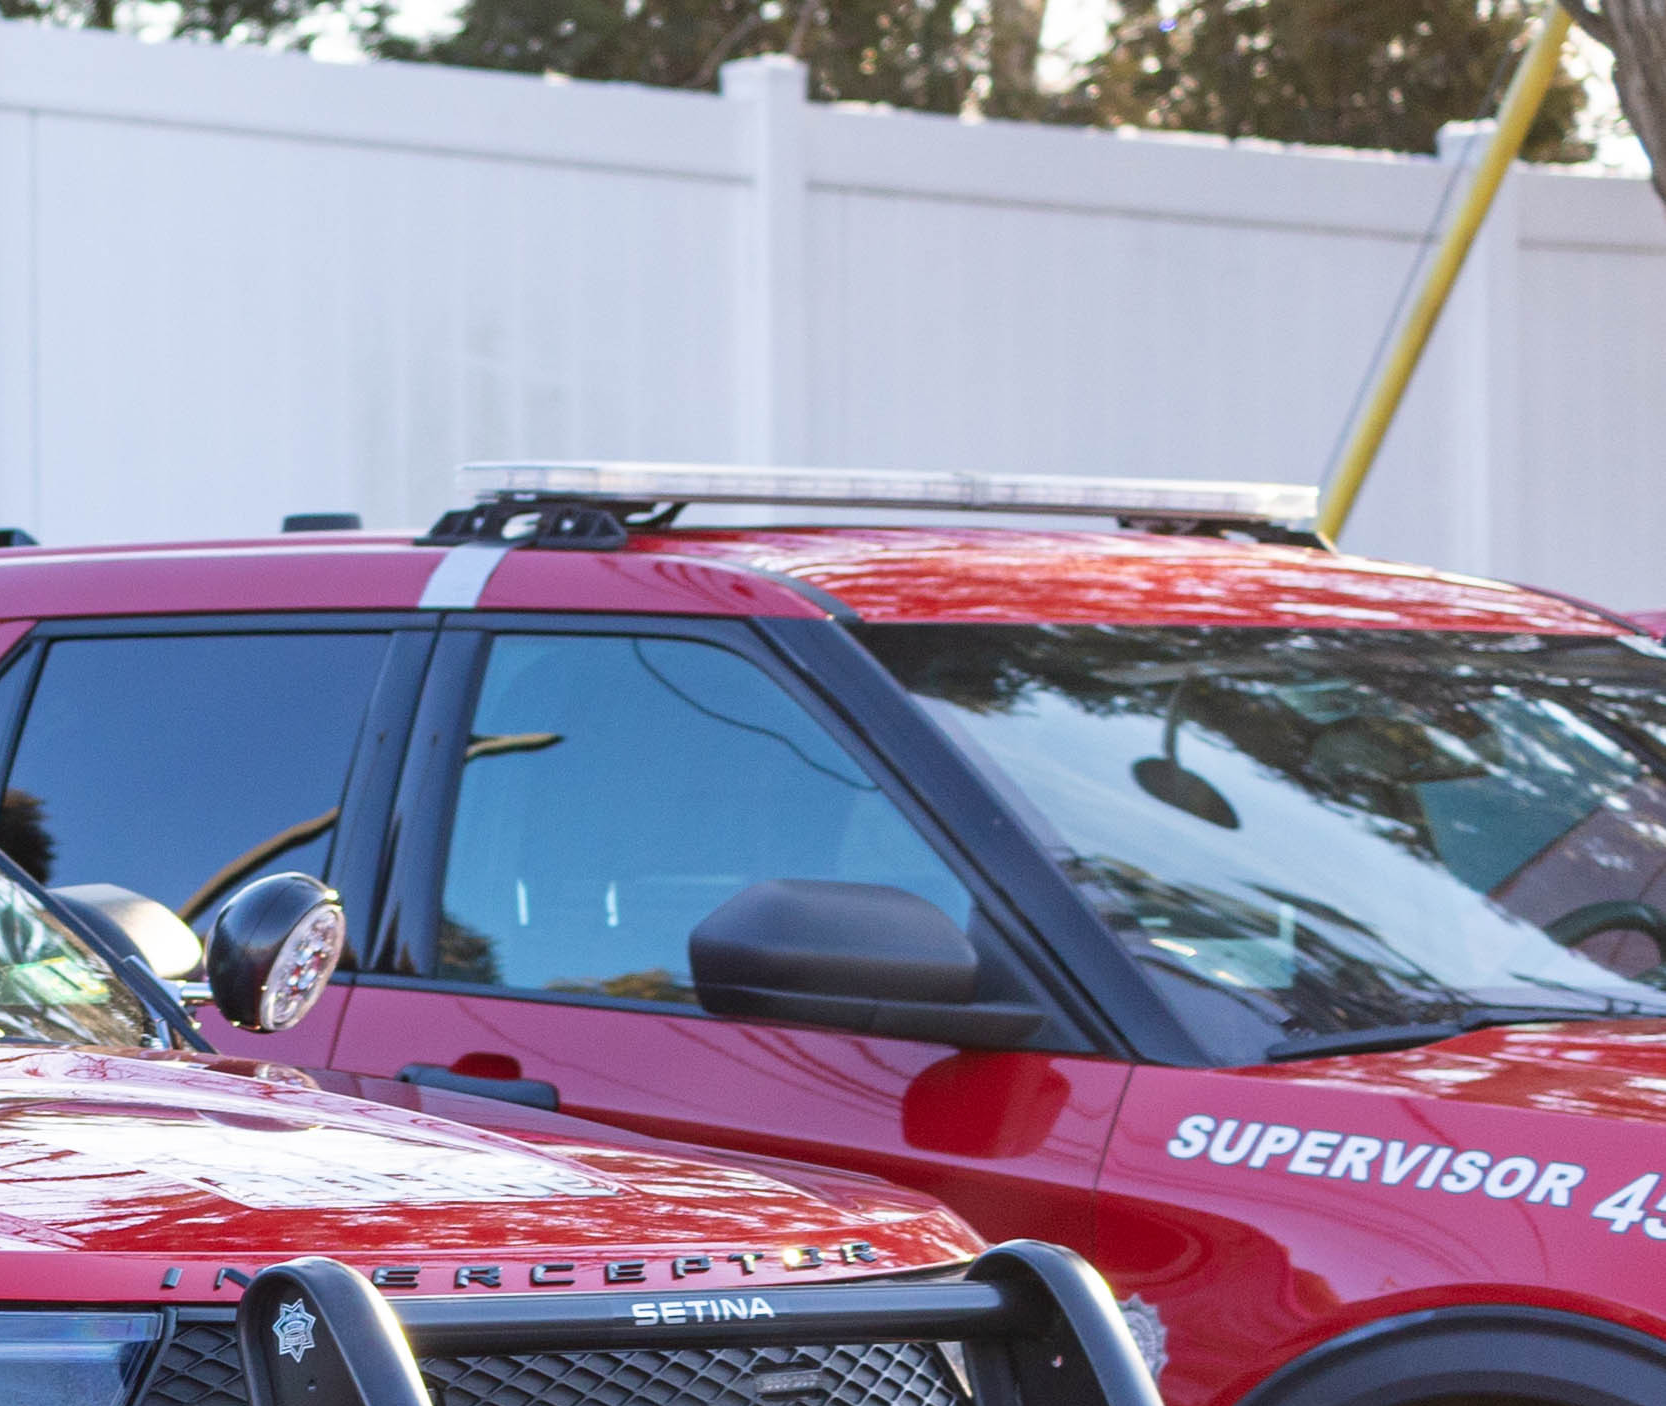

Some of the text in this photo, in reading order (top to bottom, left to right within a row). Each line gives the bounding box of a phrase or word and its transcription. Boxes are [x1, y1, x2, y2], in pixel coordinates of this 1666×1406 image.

[1167, 1113, 1586, 1207] SUPERVISOR
[159, 1240, 879, 1290] INERCEPTOR
[632, 1297, 776, 1326] SETINA
